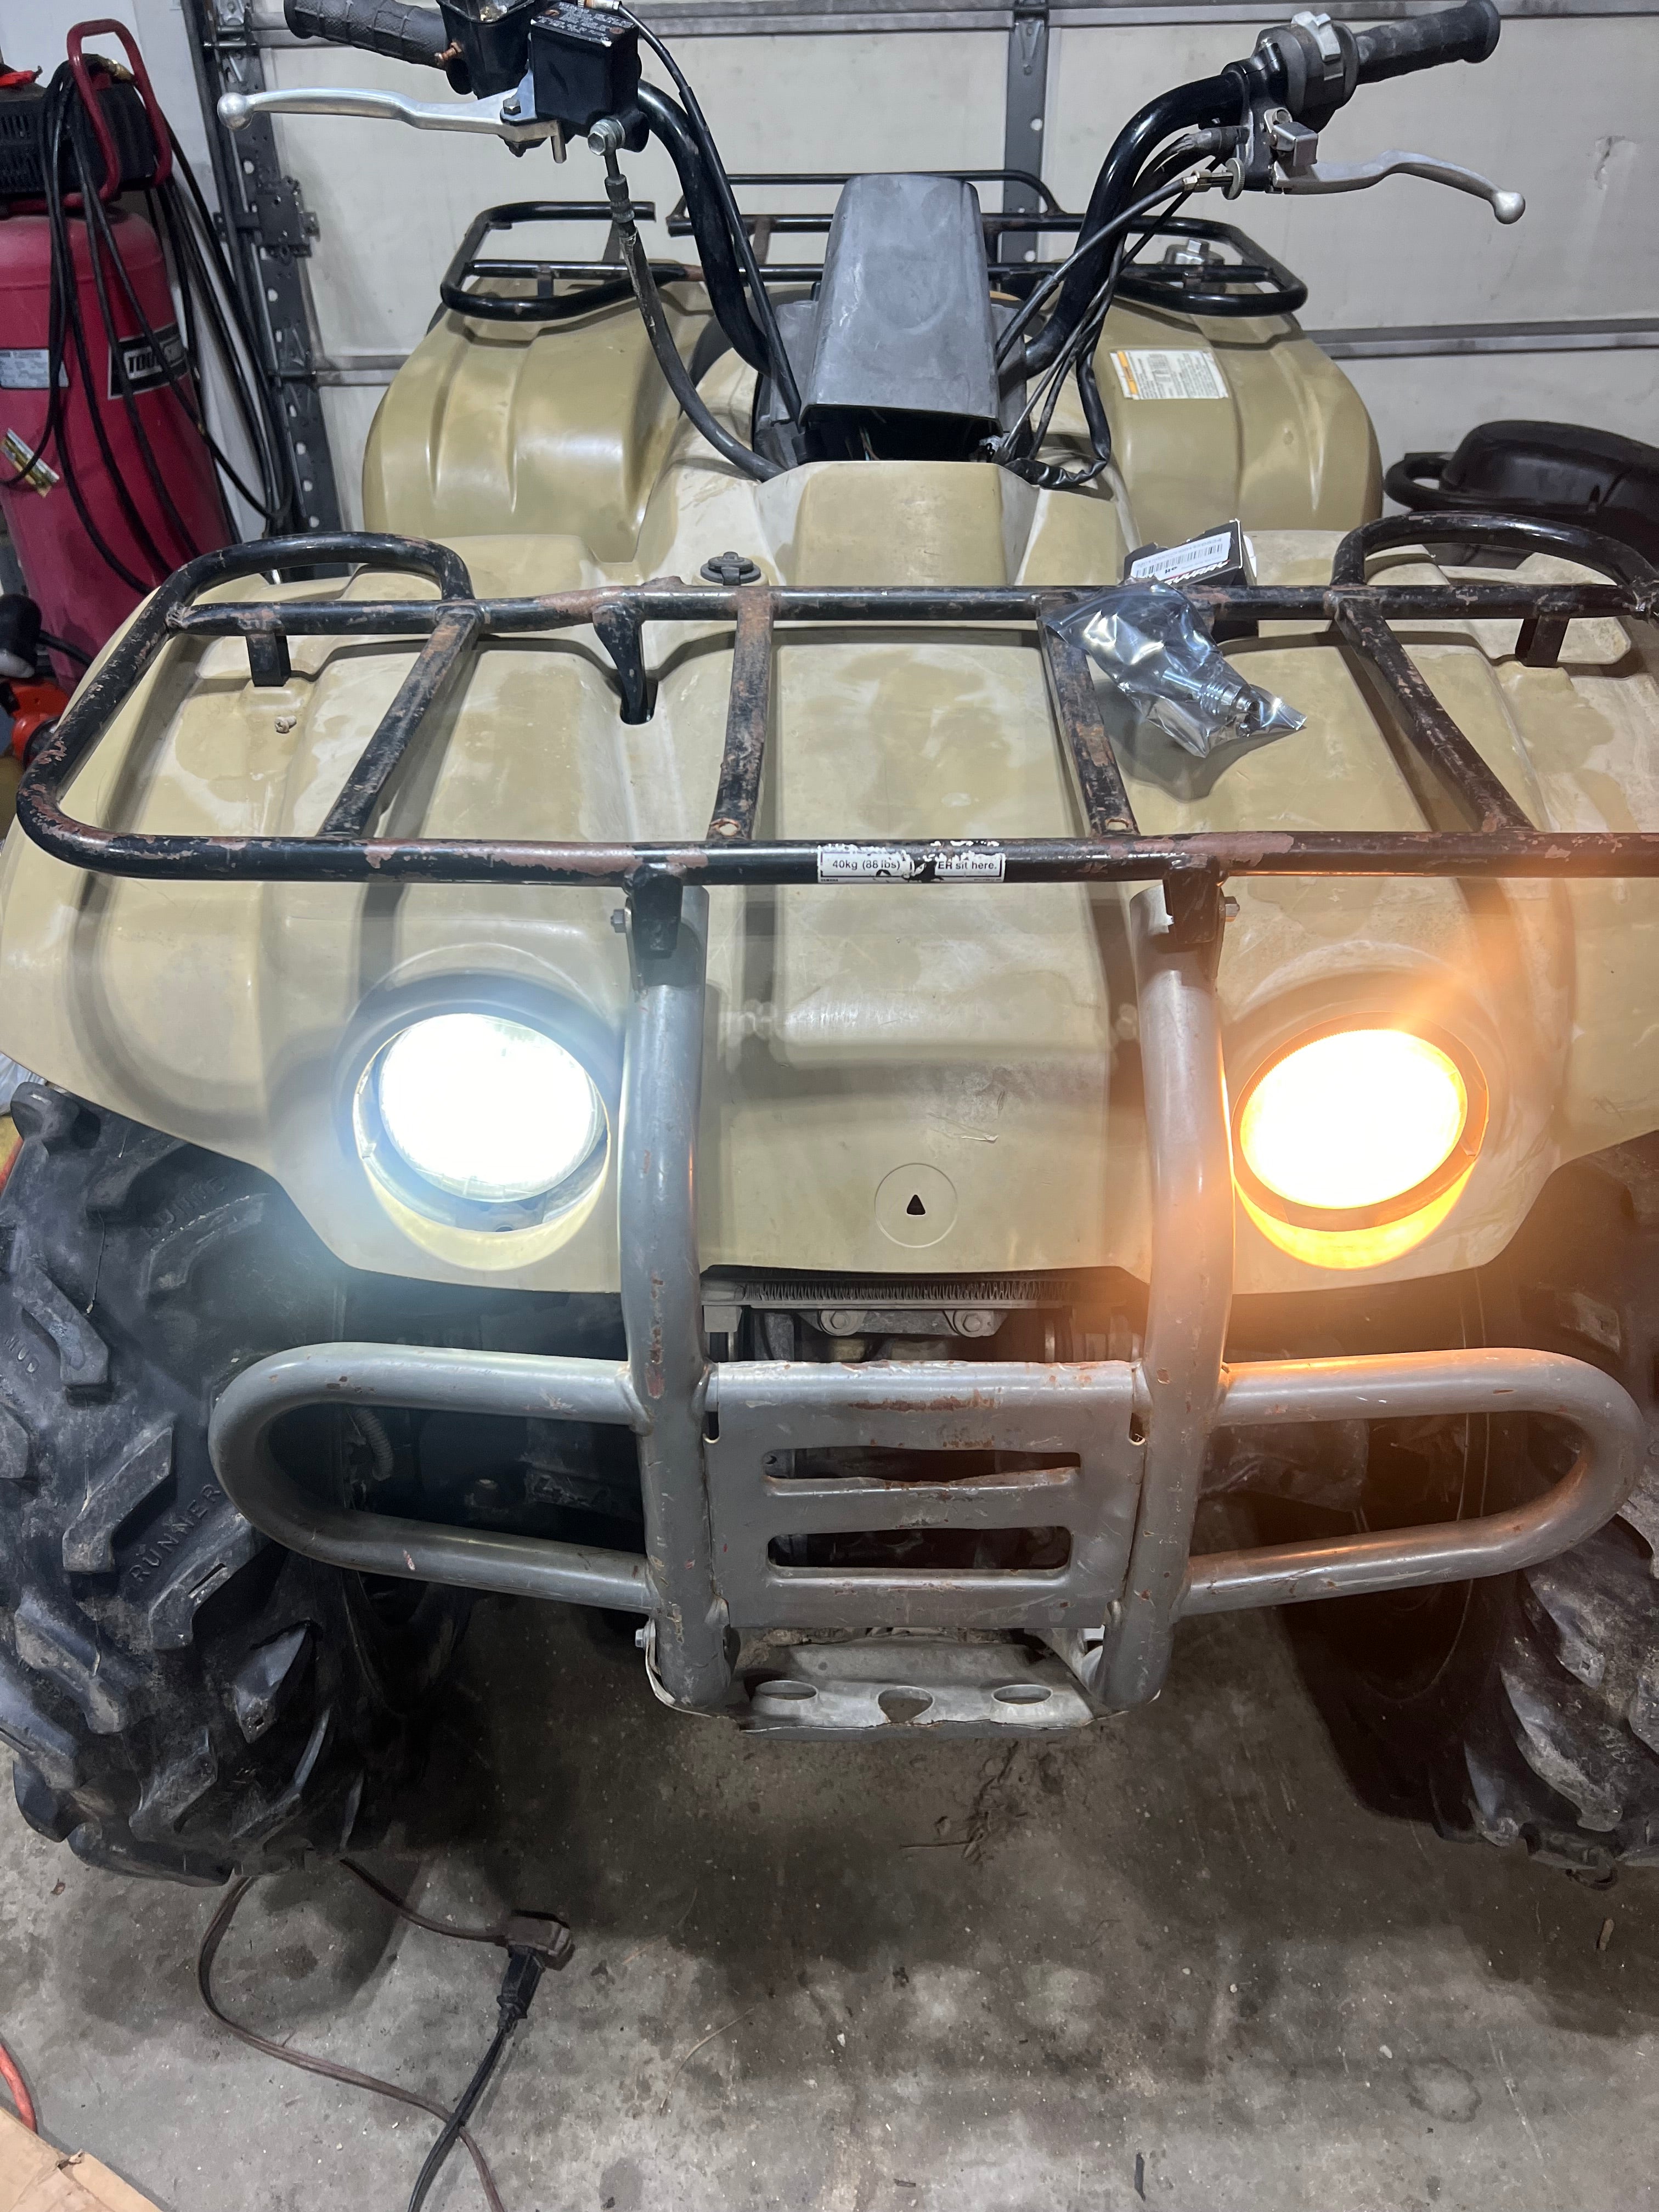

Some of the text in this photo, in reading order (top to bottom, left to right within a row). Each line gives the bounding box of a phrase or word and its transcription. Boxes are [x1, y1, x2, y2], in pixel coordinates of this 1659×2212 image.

[833, 860, 857, 870] 40kg
[881, 860, 900, 870] lbs)
[955, 860, 967, 870] sit
[972, 861, 997, 870] here.
[129, 1483, 221, 1583] RUNNER
